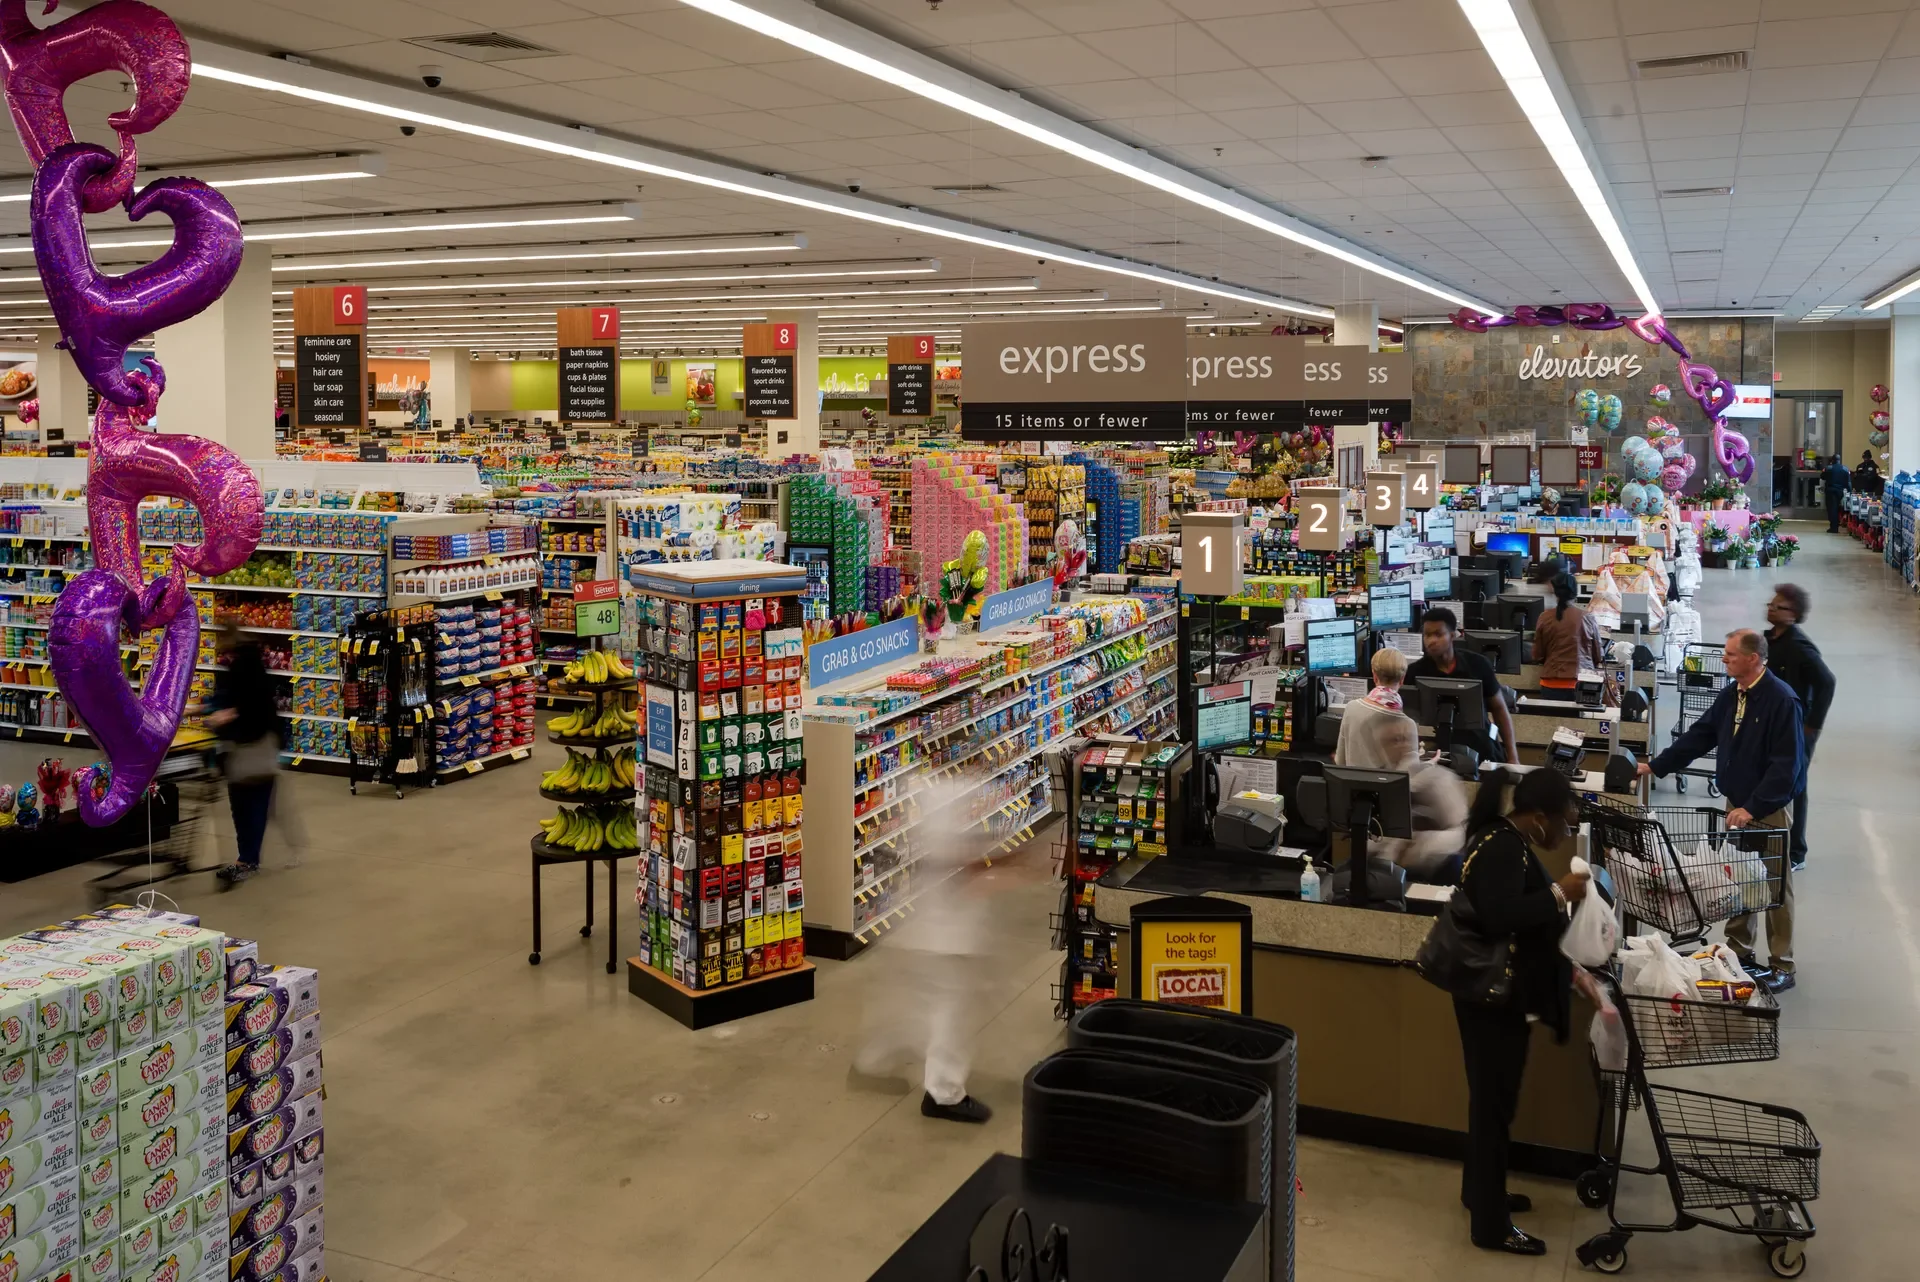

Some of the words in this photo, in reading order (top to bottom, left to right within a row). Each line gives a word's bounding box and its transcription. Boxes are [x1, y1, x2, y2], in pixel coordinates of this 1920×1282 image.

[342, 294, 353, 316] 6
[600, 315, 609, 332] 7
[304, 337, 335, 346] feminine
[780, 329, 789, 344] 8
[920, 340, 927, 353] 9
[315, 352, 340, 363] hosiery
[1000, 344, 1146, 383] express
[1518, 345, 1643, 380] elevators
[313, 368, 326, 376] hair
[566, 362, 583, 370] paper
[585, 362, 608, 370] napkins
[1187, 356, 1272, 386] press
[567, 374, 581, 382] cups
[314, 383, 325, 391] bar
[327, 384, 343, 393] soap
[314, 398, 327, 406] skin
[581, 398, 605, 406] supplies
[314, 413, 343, 421] seasonal
[569, 411, 580, 419] dog
[582, 410, 606, 418] supplies
[1186, 412, 1208, 420] ems
[1215, 412, 1228, 420] or
[1236, 410, 1275, 420] fewer
[1309, 407, 1343, 416] fewer
[995, 414, 1012, 428] 15
[1021, 414, 1065, 428] items
[1073, 417, 1090, 428] or
[1099, 413, 1148, 427] fewer
[1482, 443, 1488, 456] 7
[1413, 474, 1428, 495] 4
[1375, 486, 1391, 511] 3
[1309, 503, 1328, 532] 2
[1198, 536, 1212, 573] 1
[739, 584, 760, 592] dining
[989, 602, 1007, 620] GRAB
[1008, 600, 1013, 614] &
[1014, 597, 1025, 612] GO
[1025, 589, 1046, 608] SNACKS
[822, 649, 848, 673] GRAB
[851, 646, 857, 663] &
[860, 641, 874, 660] GO
[876, 630, 909, 655] SNACKS
[656, 707, 664, 715] EAT
[682, 699, 687, 711] a
[656, 722, 666, 733] PLAY
[683, 728, 688, 740] a
[656, 739, 666, 749] GIVE
[682, 758, 688, 770] a
[686, 787, 691, 800] a
[1120, 808, 1129, 816] 99
[1166, 932, 1196, 943] Look
[1200, 932, 1216, 943] for
[1166, 948, 1185, 958] the
[1188, 947, 1216, 961] tags!
[1162, 977, 1220, 994] LOCAL
[246, 1000, 278, 1030] CANADA
[255, 1014, 271, 1031] DRY
[206, 1033, 218, 1043] diet
[200, 1037, 223, 1053] GINGER
[205, 1046, 218, 1057] ALE
[141, 1049, 175, 1079] CANADA
[152, 1061, 169, 1080] DRY
[207, 1074, 219, 1084] diet
[200, 1078, 224, 1095] GINGER
[206, 1088, 219, 1100] ALE
[252, 1081, 282, 1110] CANADA
[52, 1098, 66, 1109] diet
[261, 1096, 276, 1113] DRY
[44, 1102, 72, 1120] GINGER
[153, 1104, 170, 1123] DRY
[51, 1113, 66, 1124] ALE
[81, 1119, 89, 1127] 12
[208, 1115, 220, 1125] diet
[202, 1119, 225, 1135] GINGER
[208, 1128, 220, 1139] ALE
[253, 1121, 284, 1151] CANADA
[52, 1144, 66, 1155] diet
[263, 1135, 277, 1153] DRY
[44, 1148, 73, 1166] GINGER
[155, 1146, 172, 1165] DRY
[208, 1156, 220, 1167] diet
[52, 1159, 67, 1171] ALE
[83, 1164, 90, 1172] 12
[202, 1160, 225, 1177] GINGER
[207, 1170, 220, 1181] ALE
[56, 1189, 70, 1201] diet
[144, 1176, 178, 1208] CANADA
[47, 1193, 77, 1212] GINGER
[155, 1190, 172, 1208] DRY
[55, 1204, 70, 1217] ALE
[83, 1209, 91, 1217] 12
[254, 1200, 285, 1232] CANADA
[264, 1215, 278, 1230] DRY
[57, 1234, 71, 1247] diet
[49, 1238, 78, 1258] GINGER
[204, 1242, 227, 1260] GINGER
[56, 1249, 71, 1263] ALE
[210, 1252, 222, 1264] ALE
[256, 1241, 285, 1272] CANADA
[265, 1254, 280, 1271] DRY
